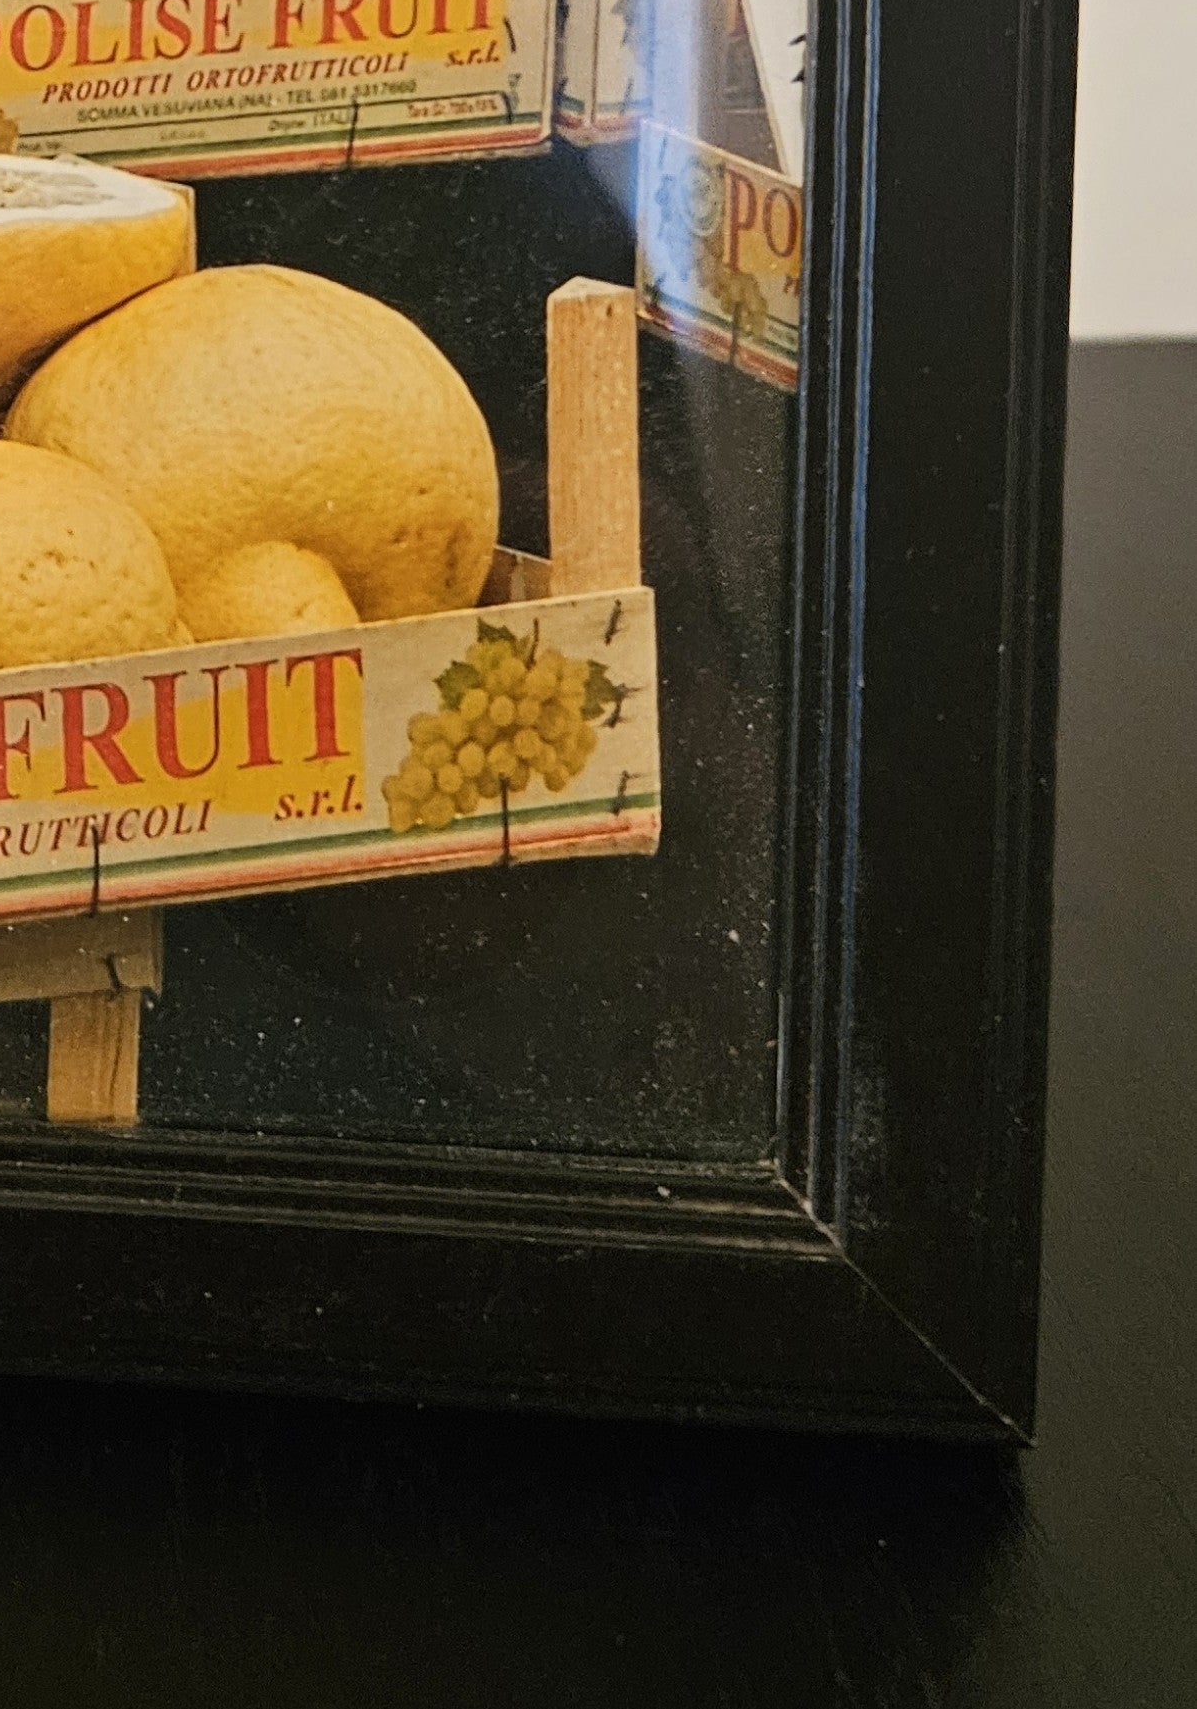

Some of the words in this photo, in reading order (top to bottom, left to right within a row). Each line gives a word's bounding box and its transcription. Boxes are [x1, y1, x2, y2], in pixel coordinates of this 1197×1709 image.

[42, 72, 173, 104] PRODOTTI
[186, 52, 409, 92] ORTOFRUTTICOLI
[446, 40, 501, 68] s.r.l.
[274, 774, 364, 824] s.r.l.
